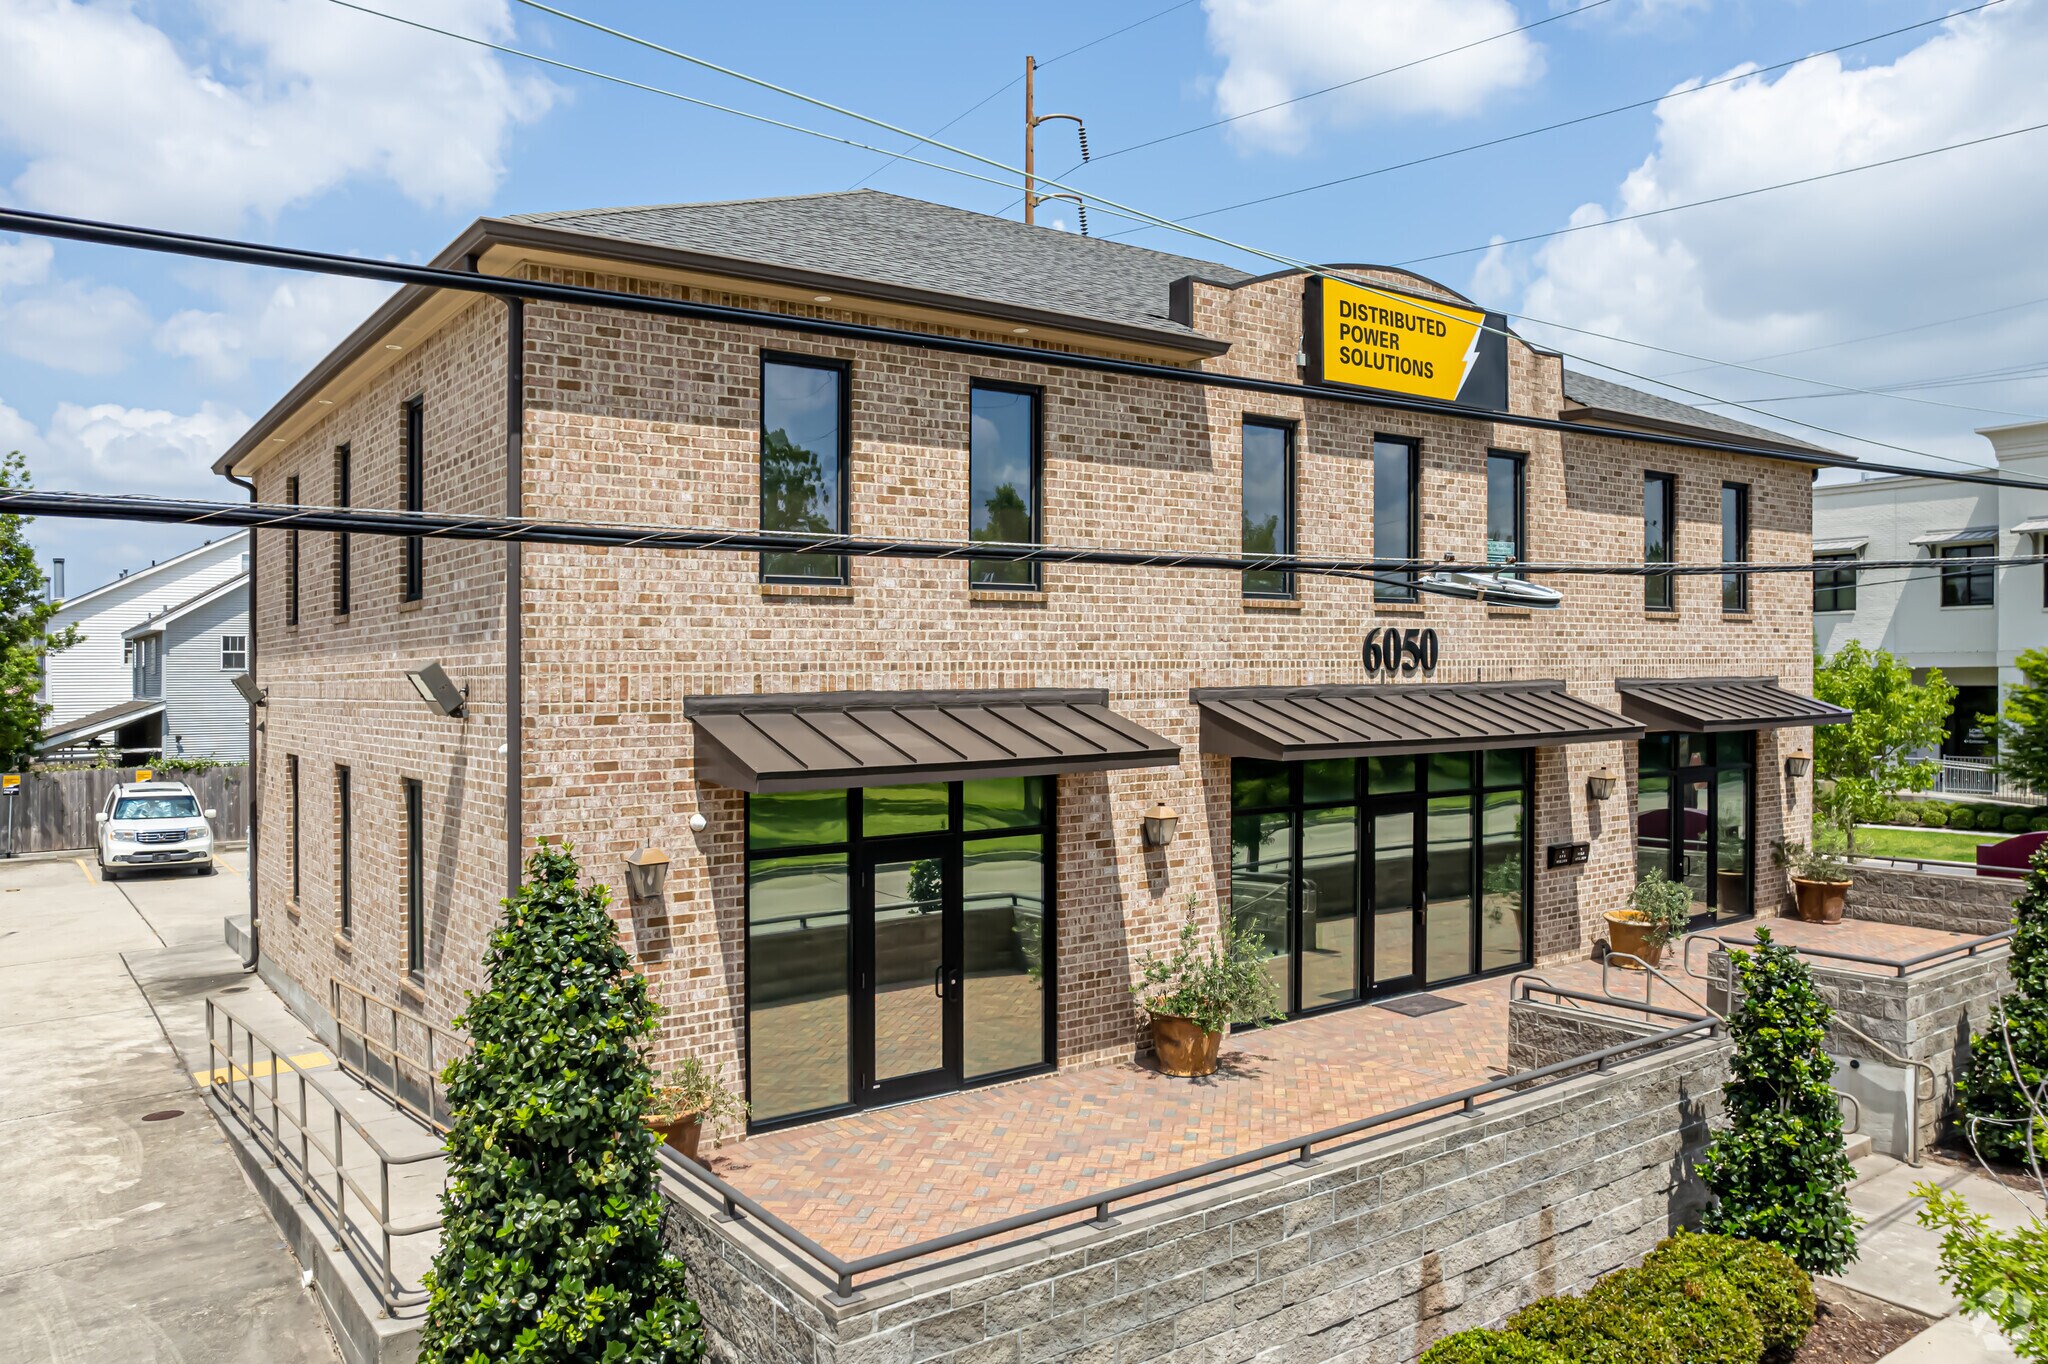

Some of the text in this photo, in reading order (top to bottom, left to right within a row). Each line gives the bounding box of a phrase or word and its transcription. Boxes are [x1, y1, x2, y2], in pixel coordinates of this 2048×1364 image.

[1339, 300, 1447, 338] DISTRIBUTED
[1339, 323, 1400, 351] POWER
[1339, 346, 1434, 379] SOLUTIONS
[1362, 627, 1439, 672] 6050
